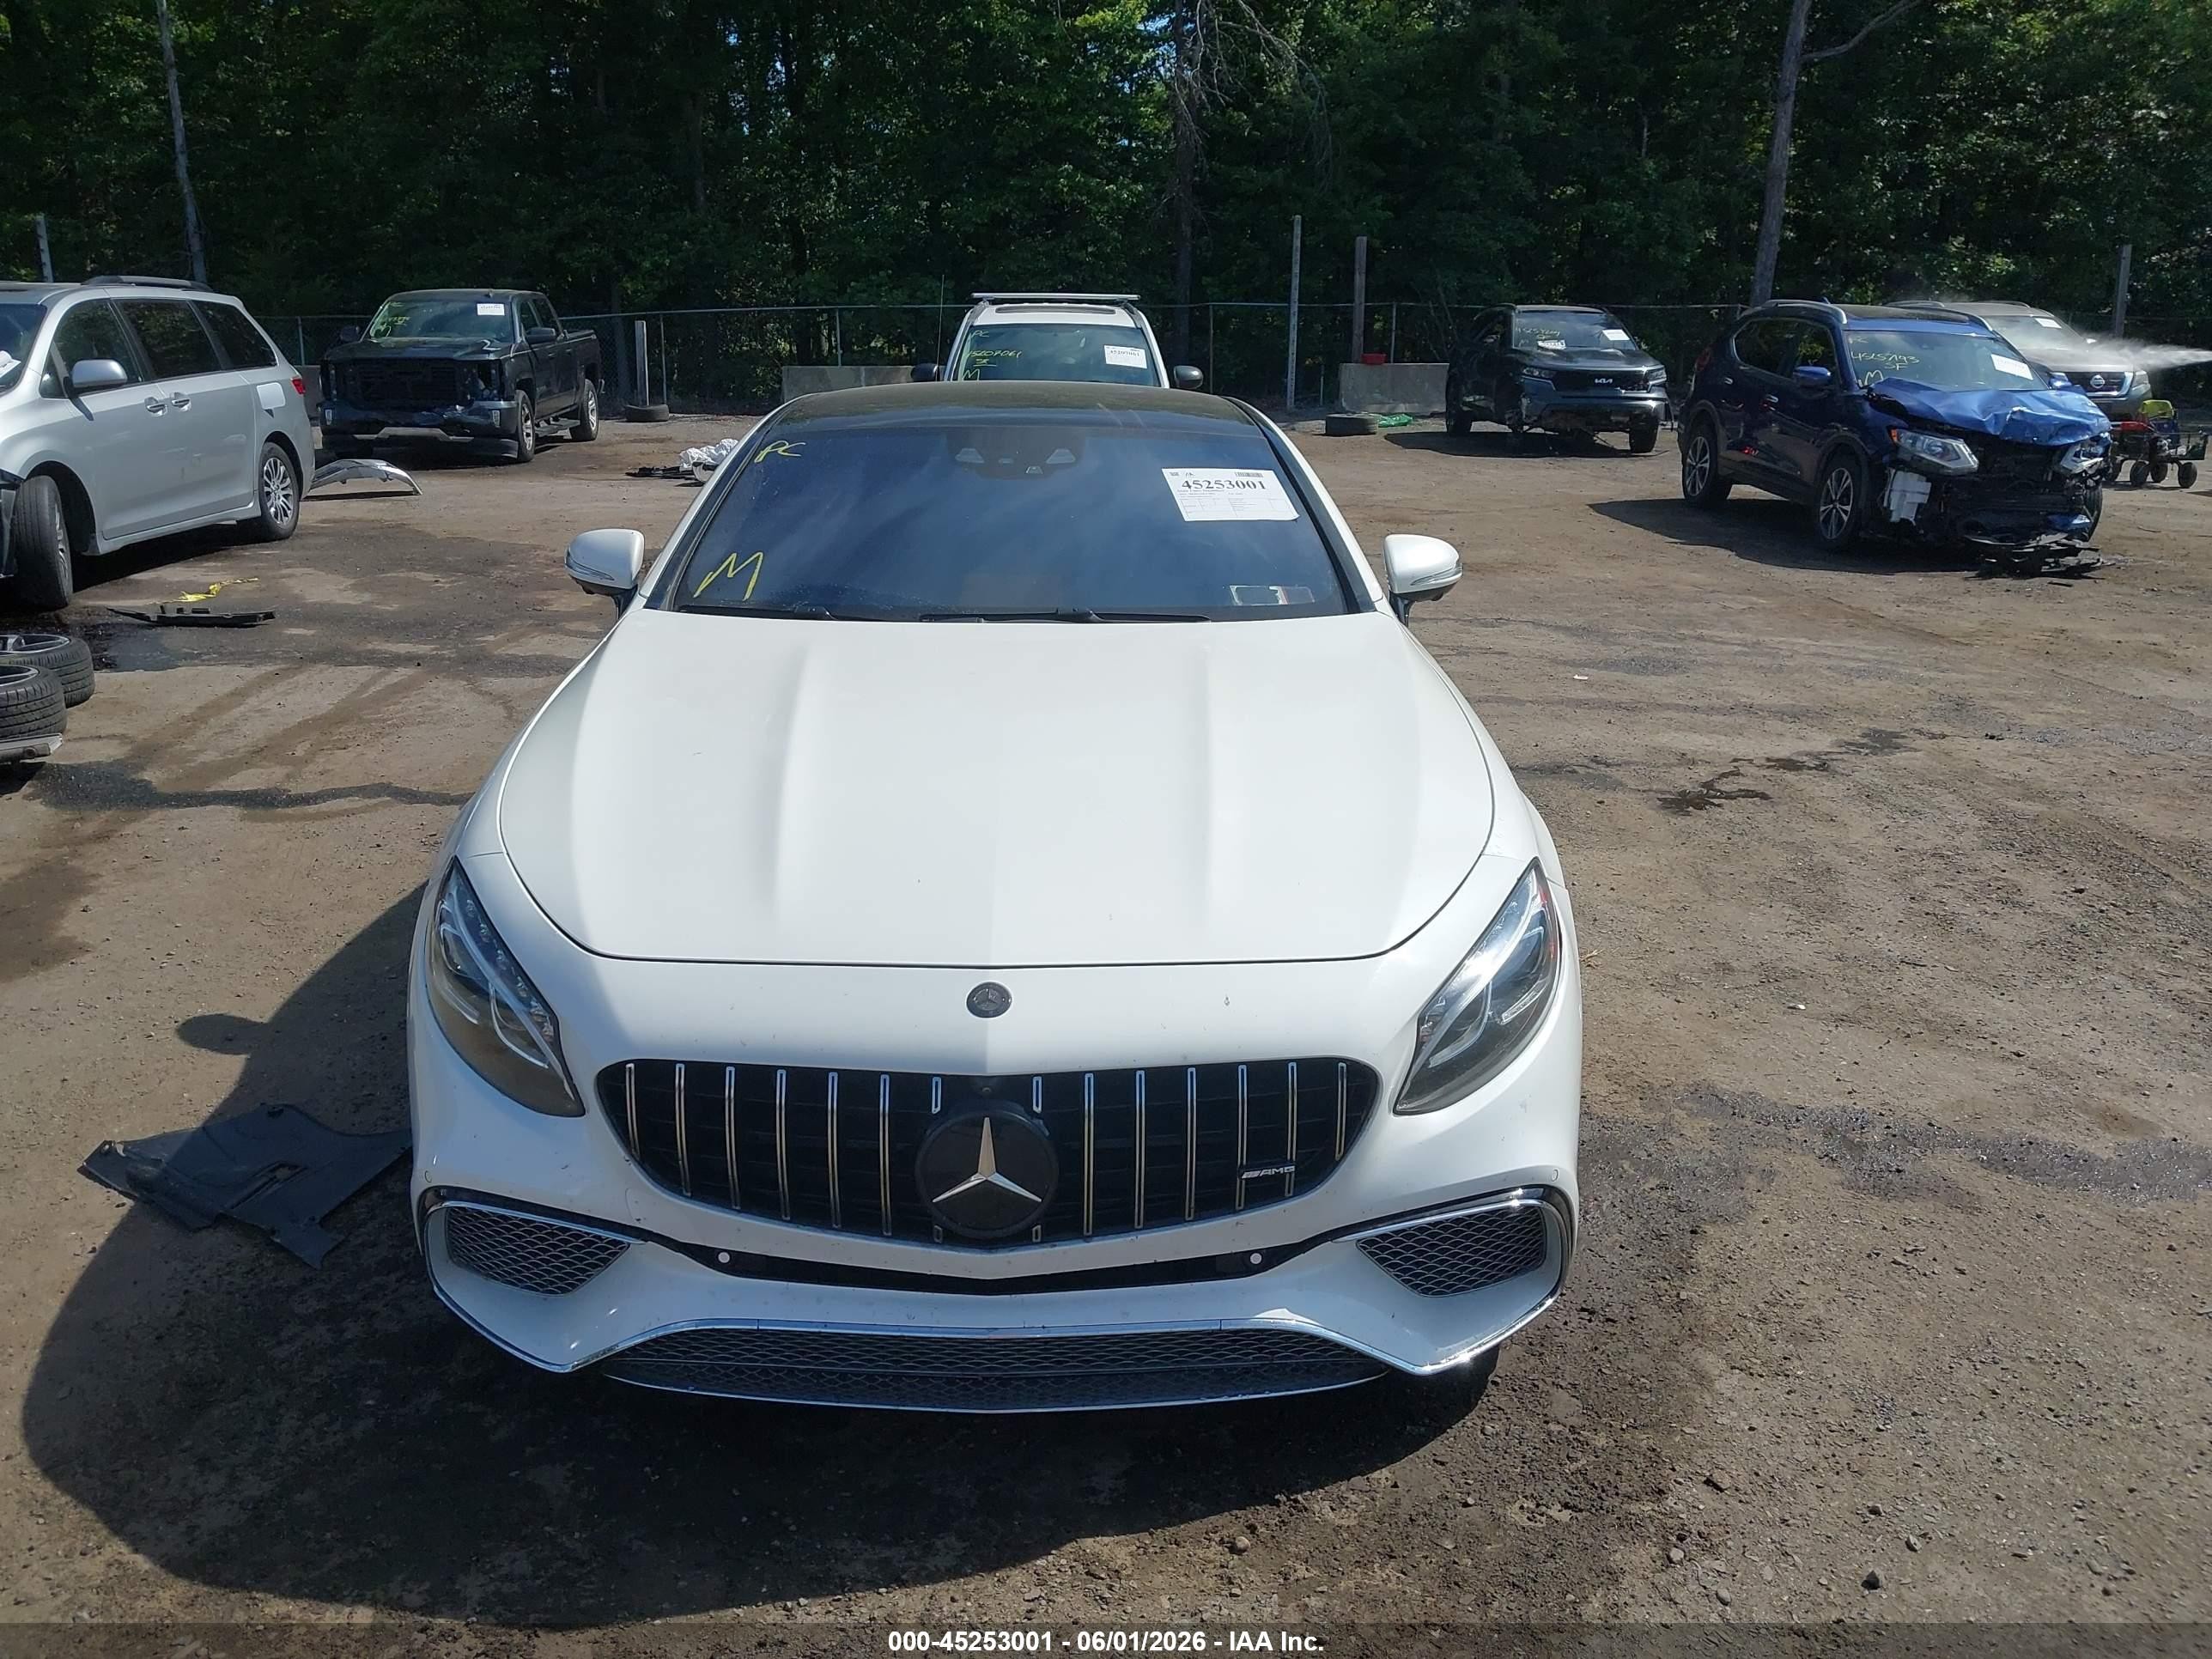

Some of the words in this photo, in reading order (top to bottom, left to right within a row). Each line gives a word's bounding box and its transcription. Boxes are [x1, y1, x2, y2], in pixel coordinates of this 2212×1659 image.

[754, 440, 806, 464] PC
[1182, 479, 1267, 490] 45253001
[693, 551, 764, 602] M
[1260, 1165, 1296, 1176] AMG
